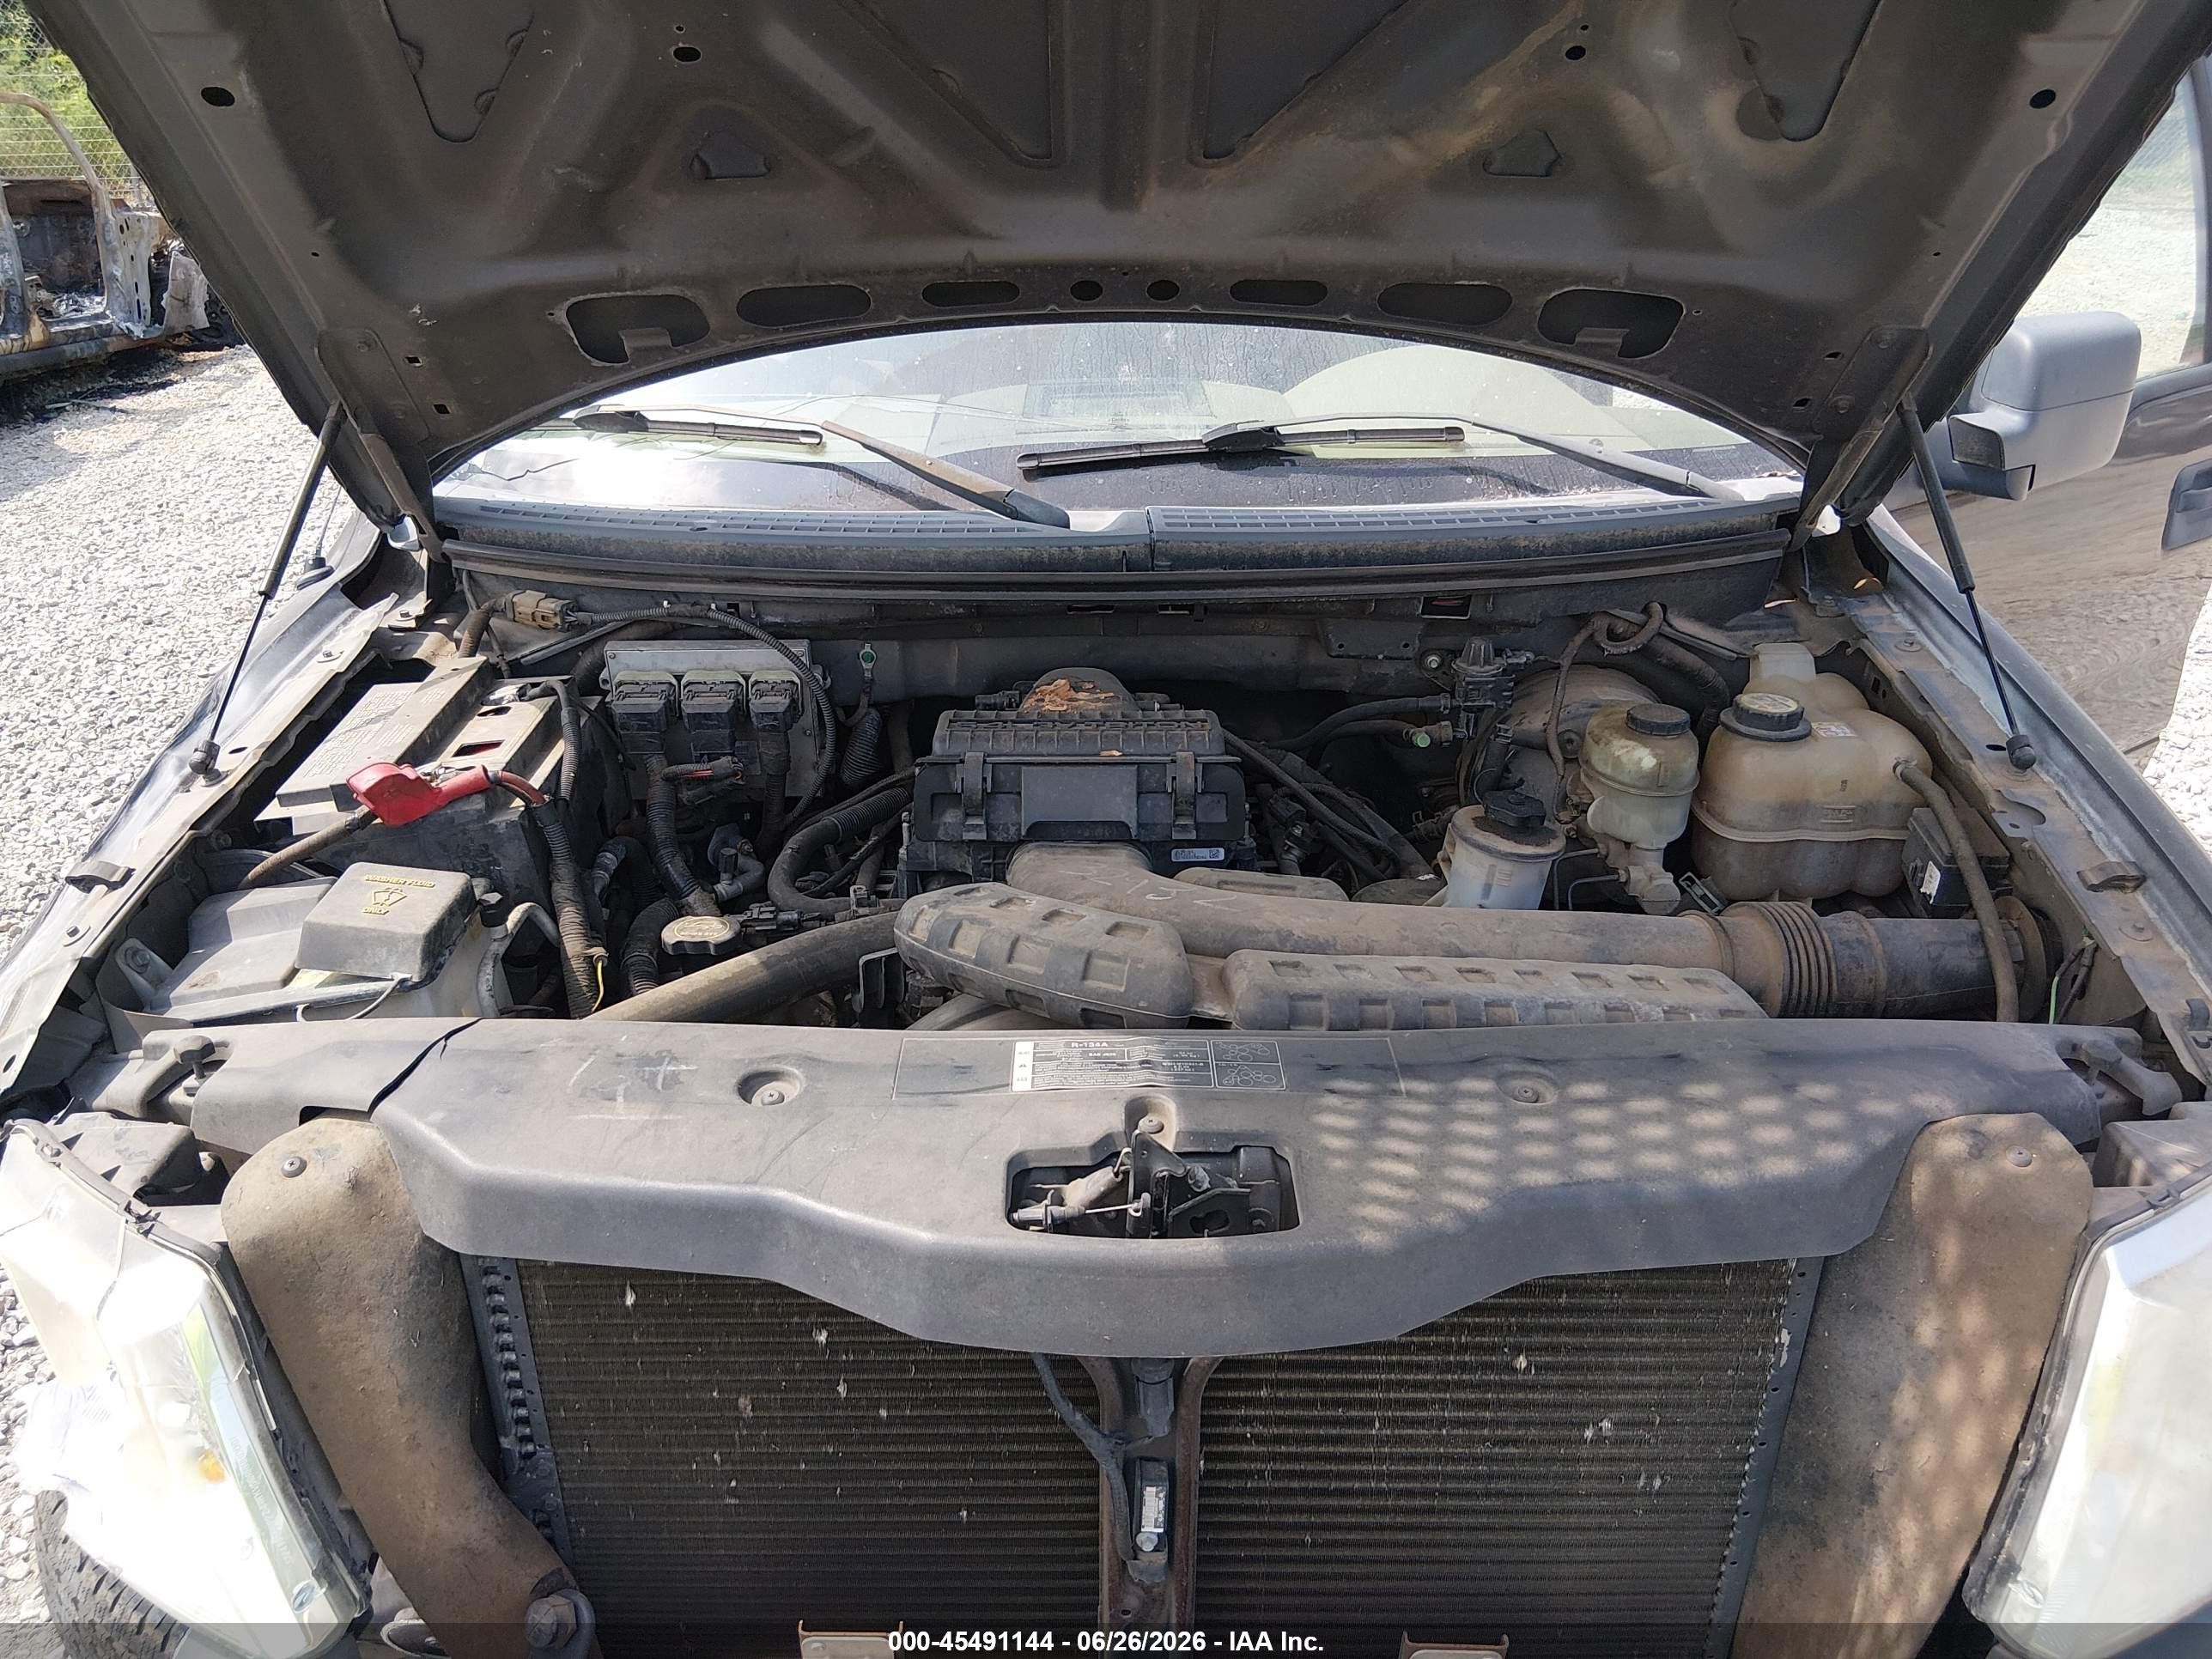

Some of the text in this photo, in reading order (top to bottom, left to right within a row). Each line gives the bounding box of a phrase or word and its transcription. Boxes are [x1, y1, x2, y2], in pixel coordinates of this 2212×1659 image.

[365, 874, 436, 888] WASHER FLUID
[362, 906, 390, 915] ONLY
